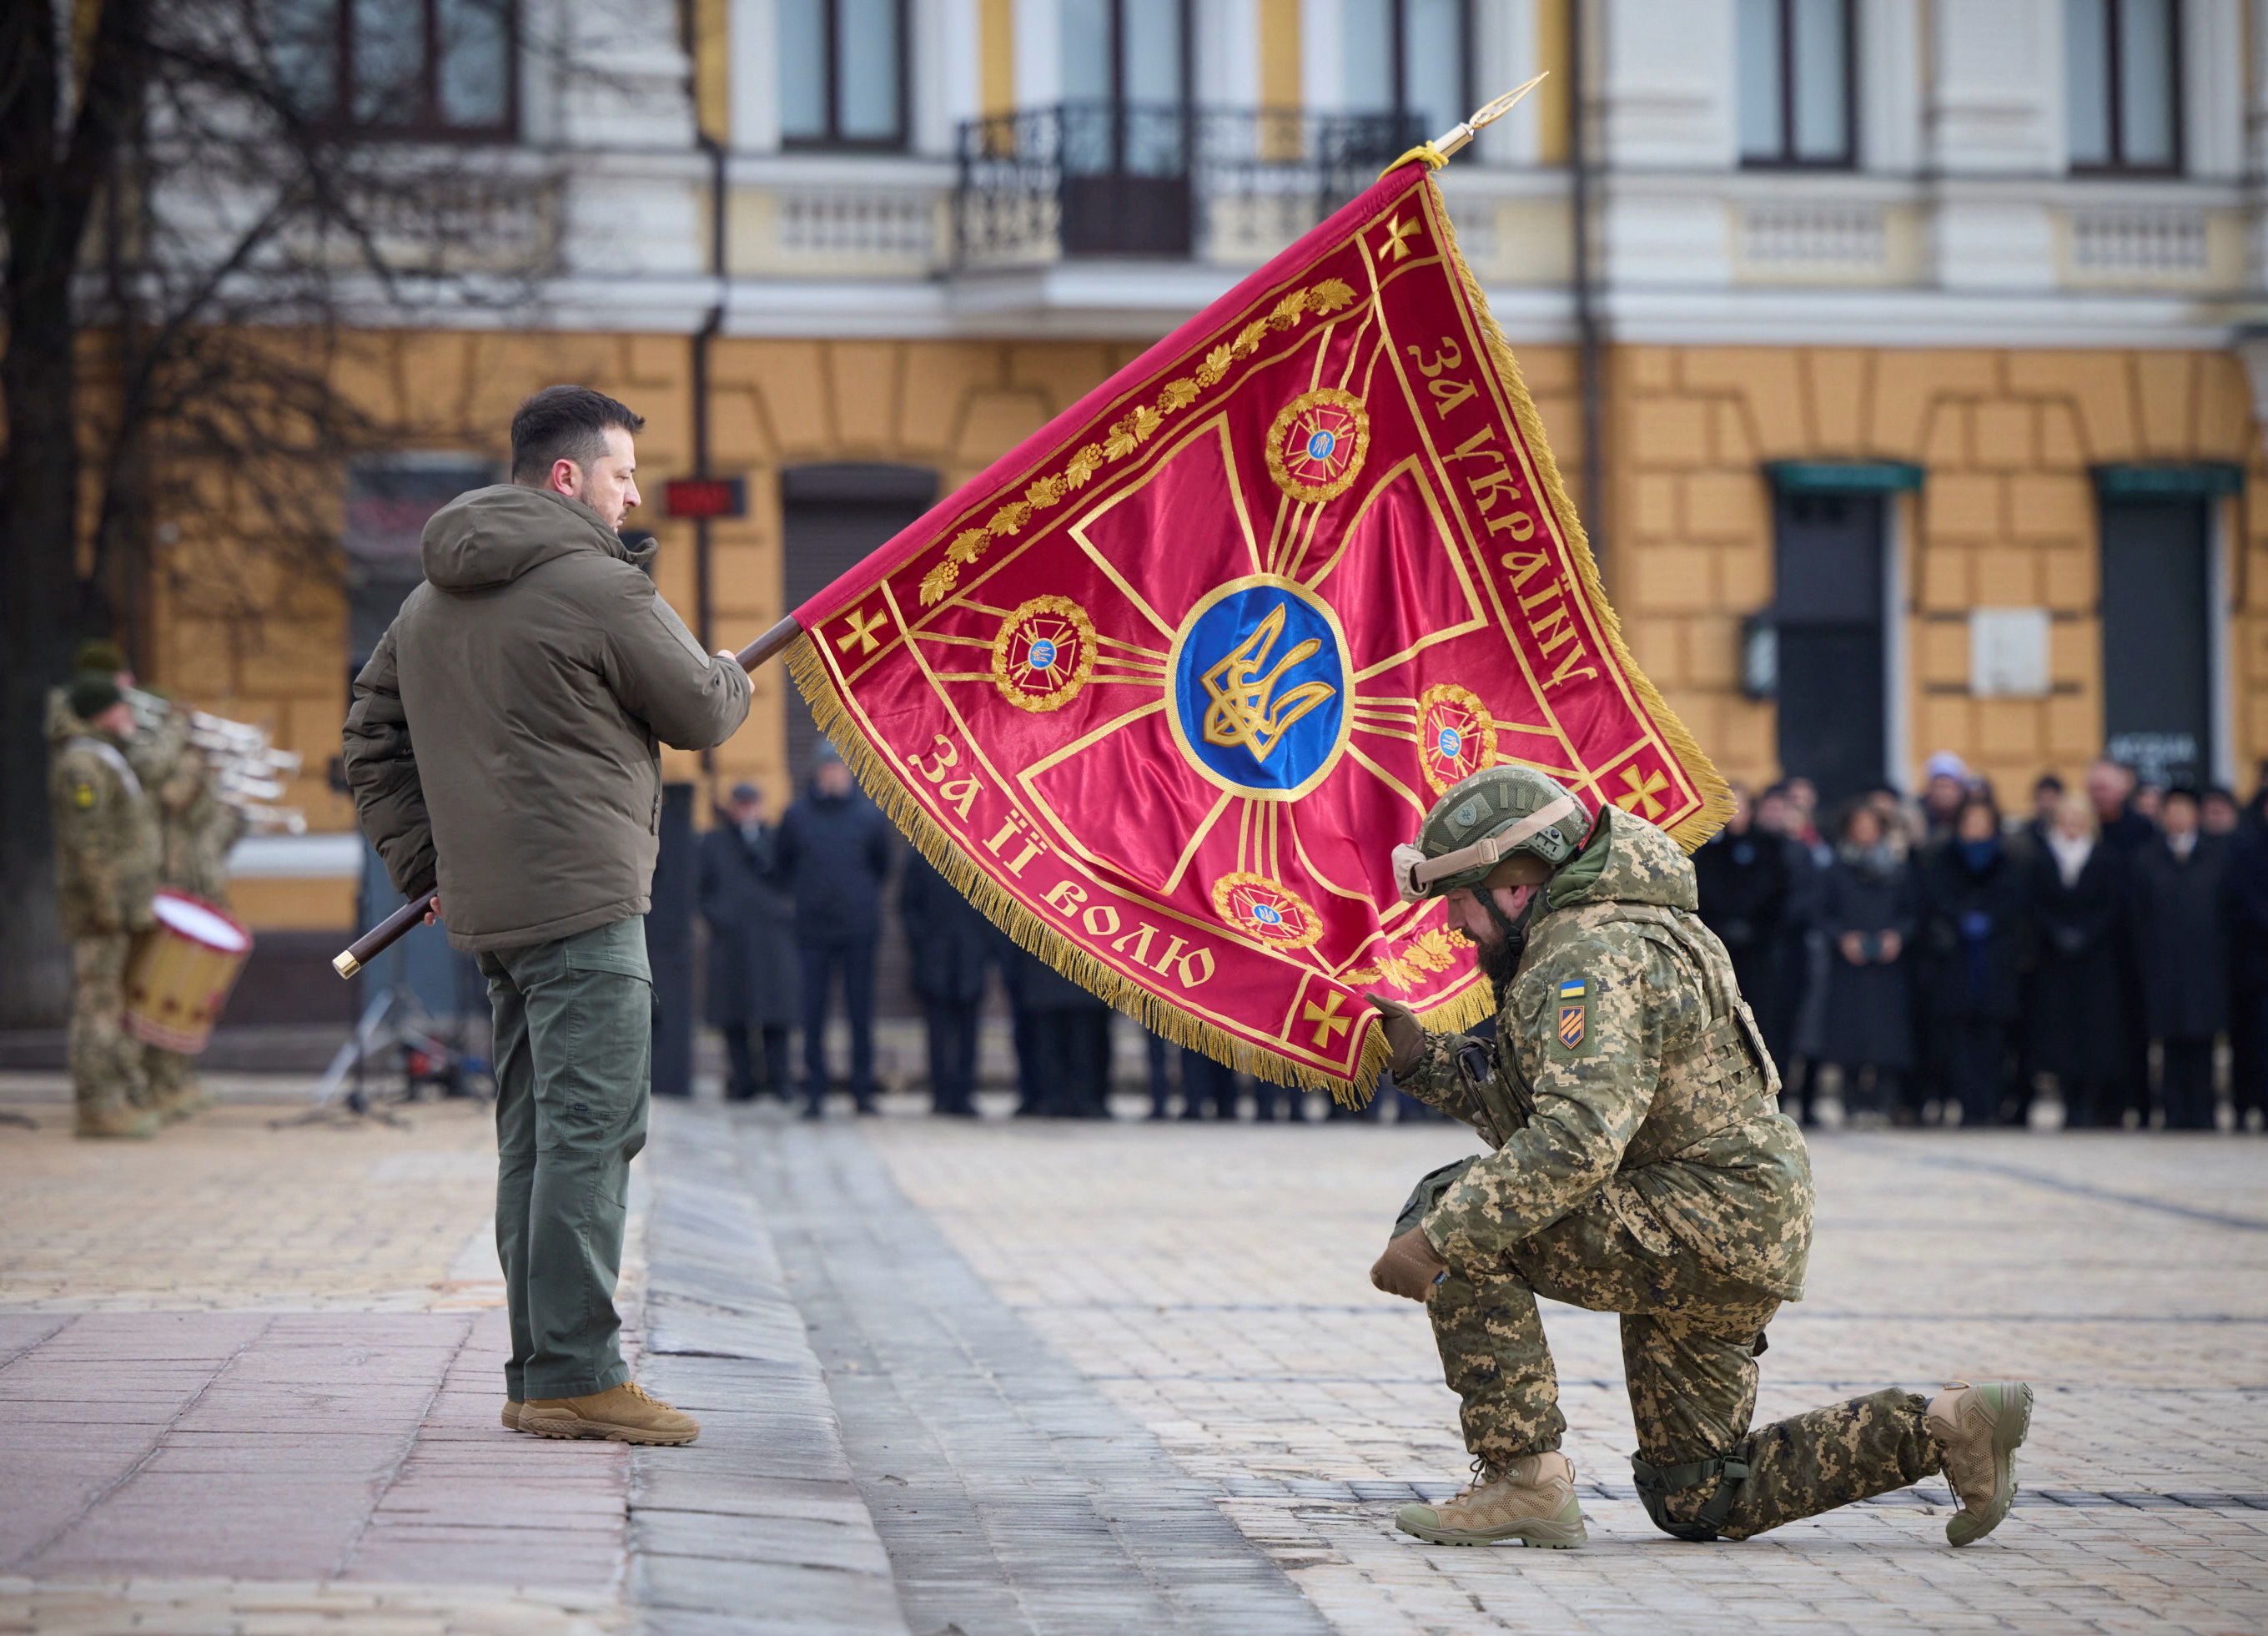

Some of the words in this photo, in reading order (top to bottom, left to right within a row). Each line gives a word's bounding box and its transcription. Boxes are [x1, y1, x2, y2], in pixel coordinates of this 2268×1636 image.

[1408, 336, 1479, 420] ЗА
[1442, 424, 1598, 691] УКРАЇНУ
[908, 734, 984, 823] ЗА
[983, 810, 1049, 878] ЇЇ
[1039, 880, 1215, 988] ВОЛЮ
